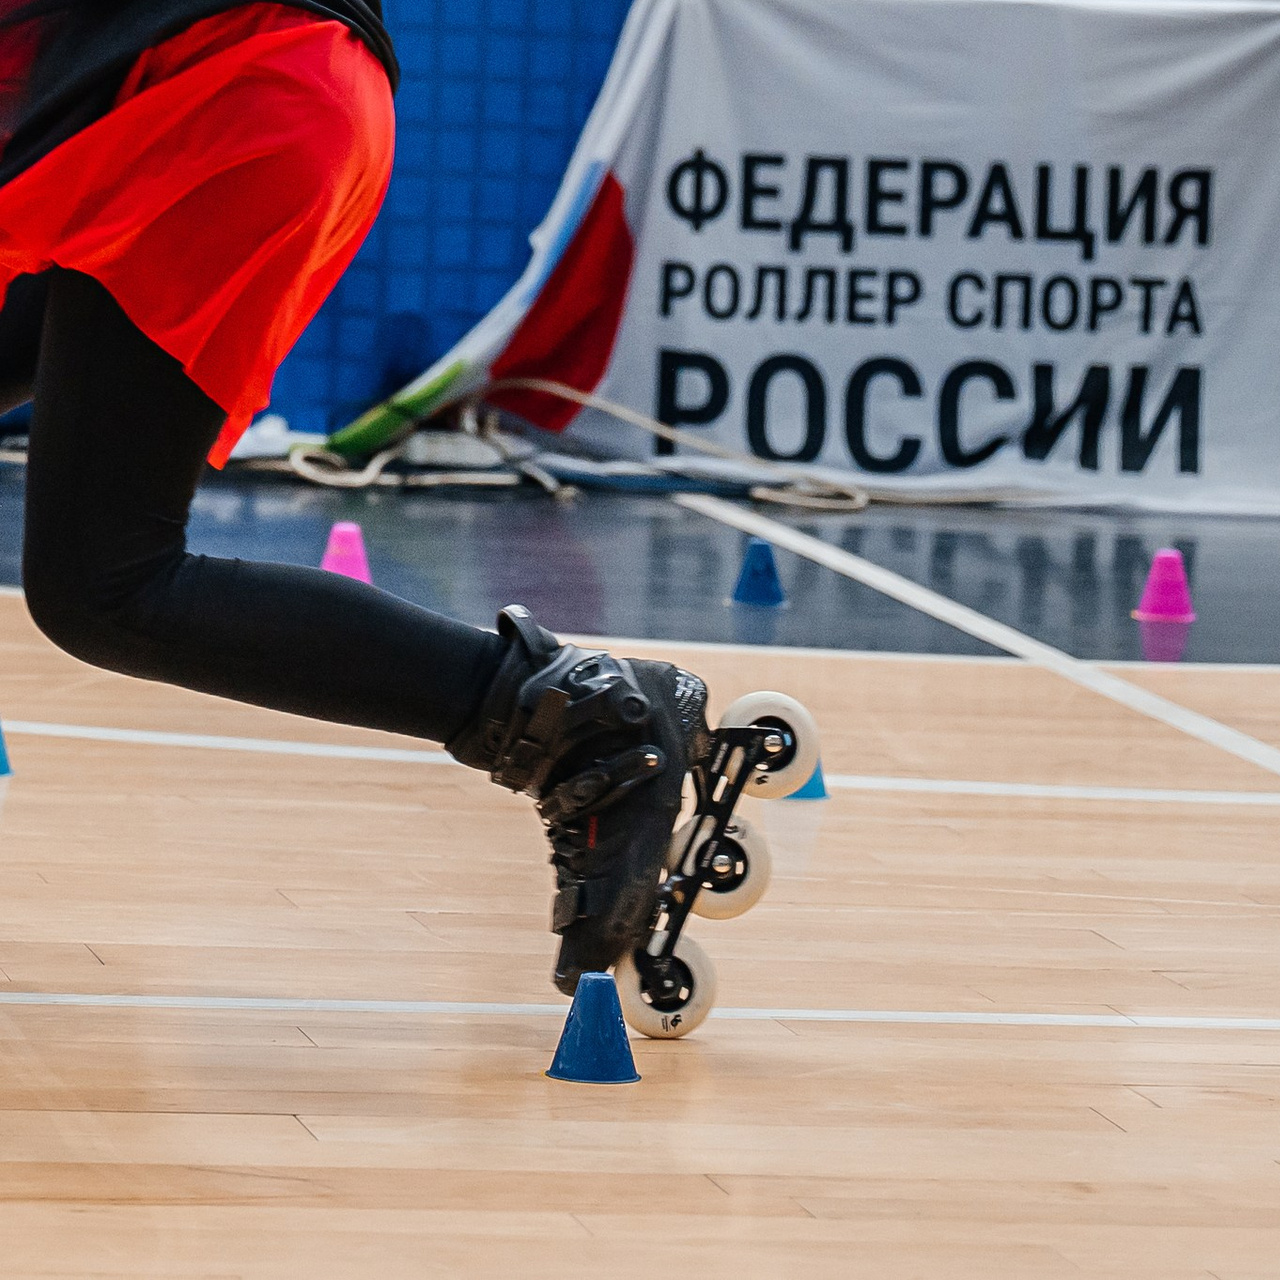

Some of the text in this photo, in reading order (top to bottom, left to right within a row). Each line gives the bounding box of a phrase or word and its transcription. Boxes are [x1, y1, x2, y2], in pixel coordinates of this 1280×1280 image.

[666, 148, 1213, 260] ФЕДЕРАЦИЯ
[660, 261, 1203, 336] РОЛЛЕР СПОРТА
[654, 348, 1203, 476] РОССИИ
